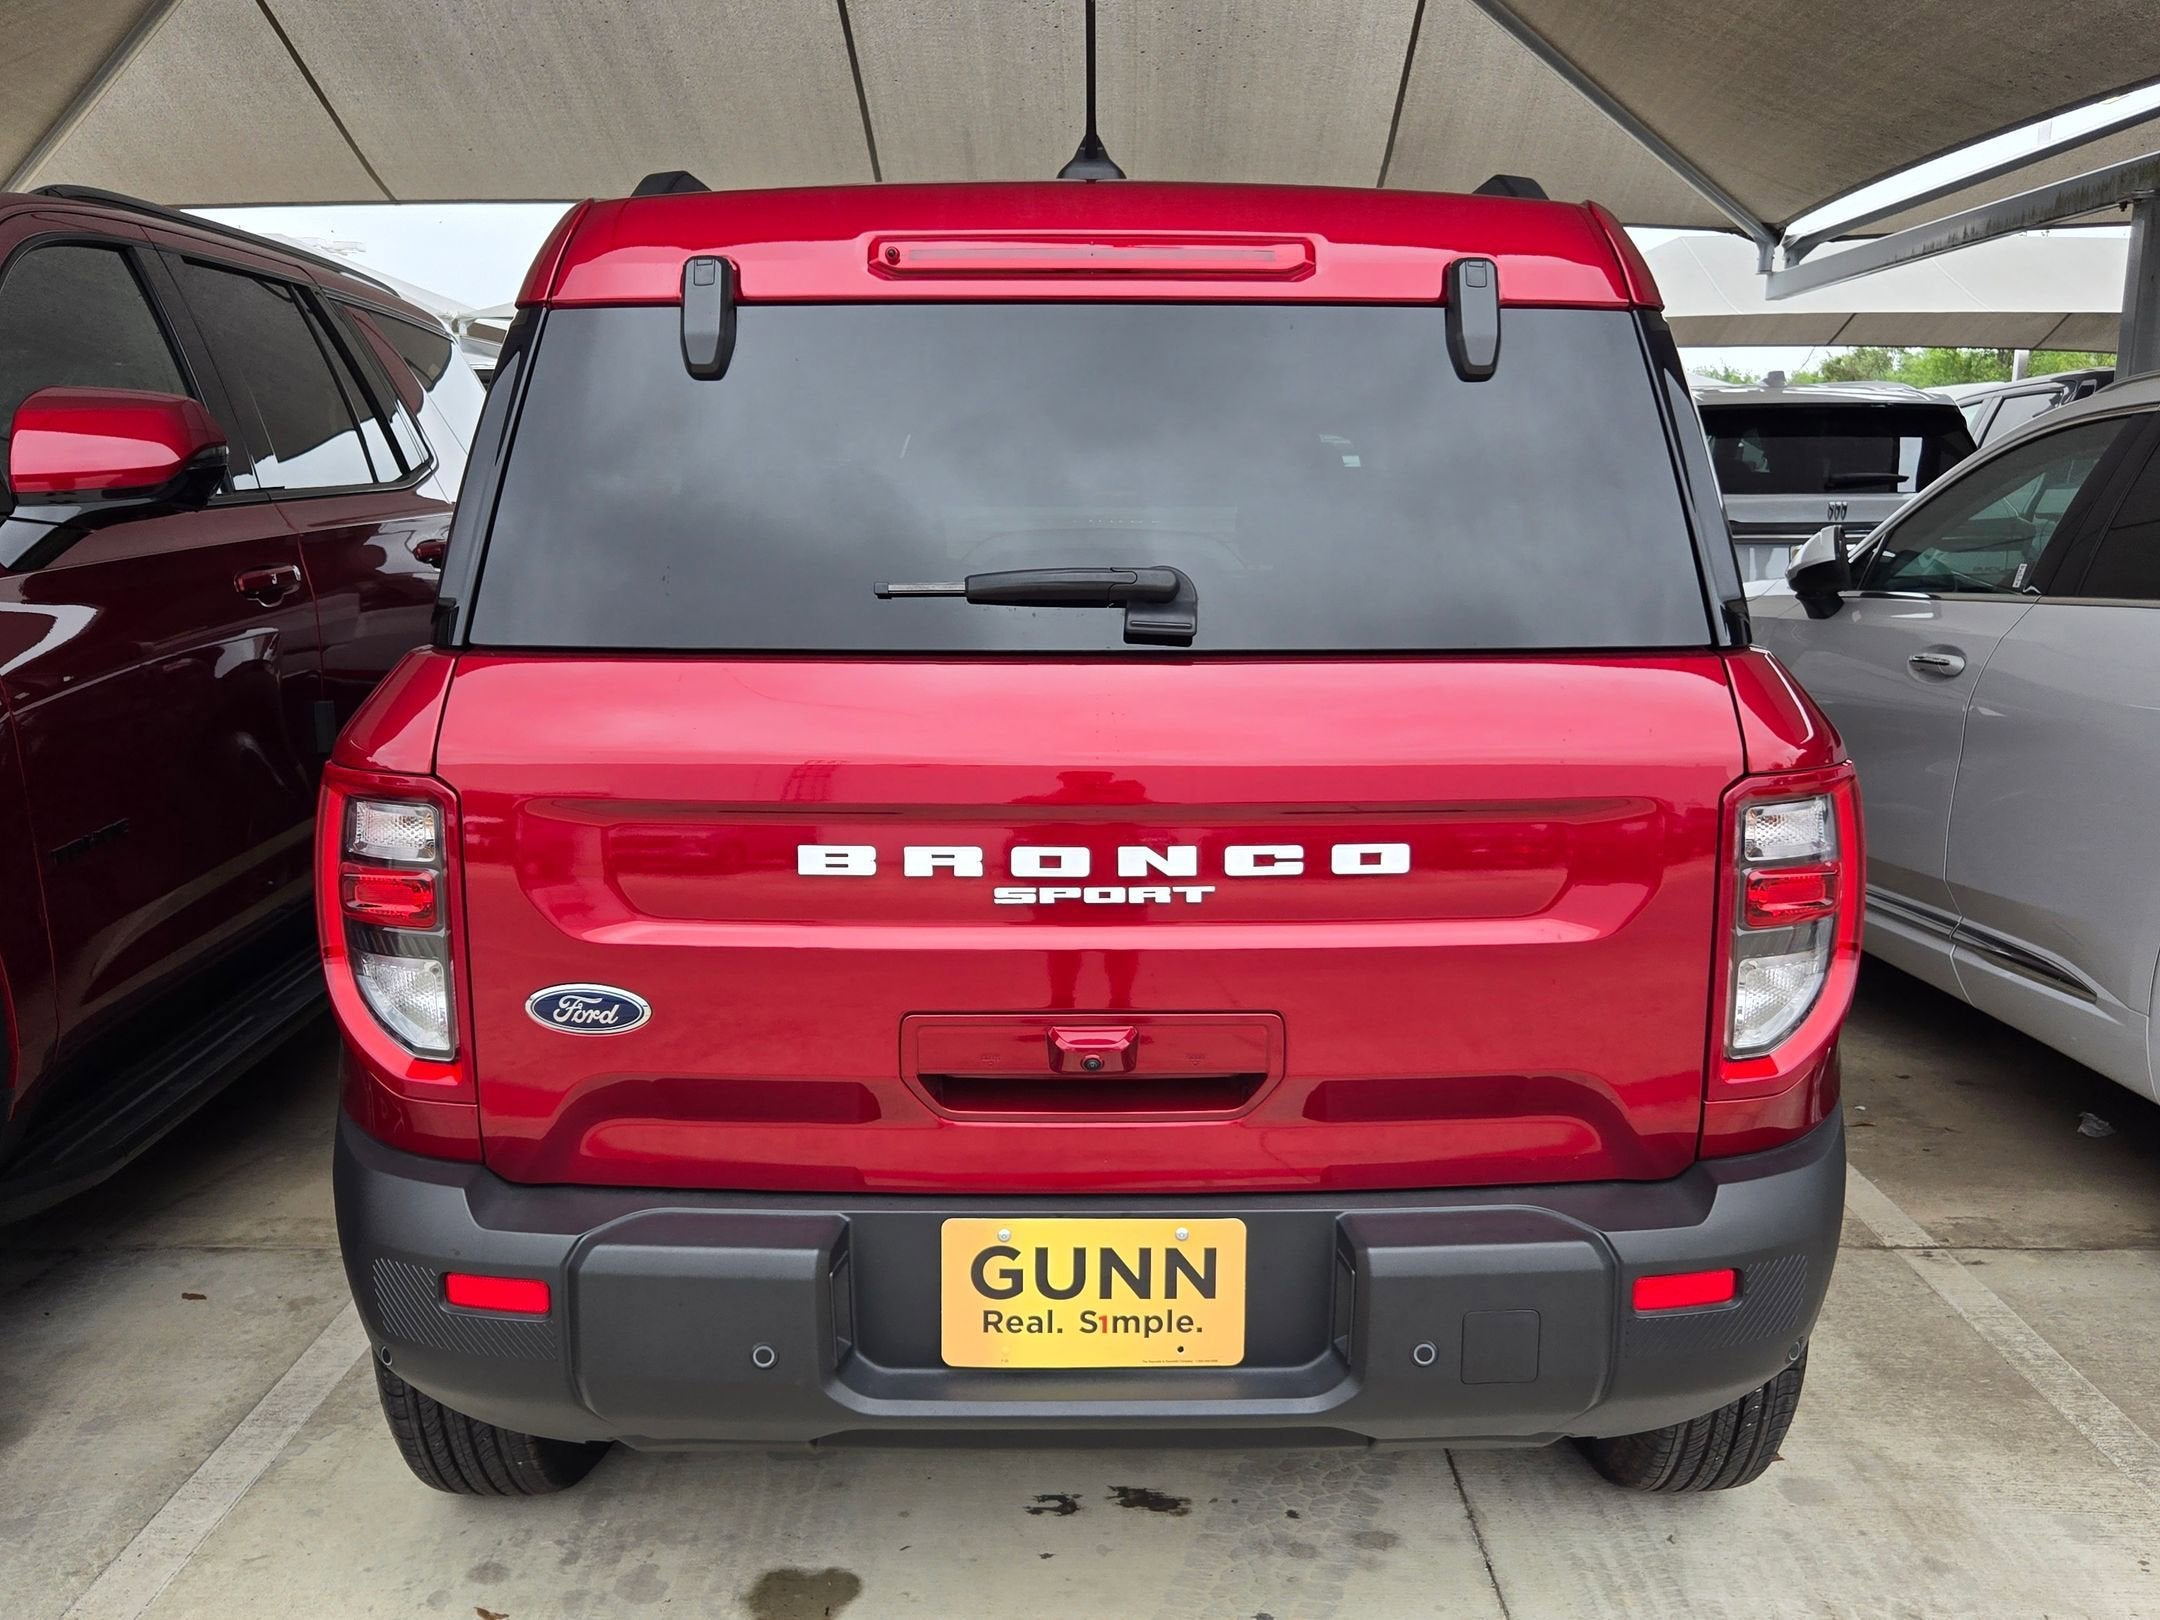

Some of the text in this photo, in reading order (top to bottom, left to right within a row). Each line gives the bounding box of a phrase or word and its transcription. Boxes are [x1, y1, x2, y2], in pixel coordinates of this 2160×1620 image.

[797, 842, 1412, 878] BRONCO
[993, 886, 1216, 905] SPORT
[552, 994, 620, 1024] Ford
[970, 1245, 1217, 1300] GUNN
[982, 1309, 1063, 1334] Real.
